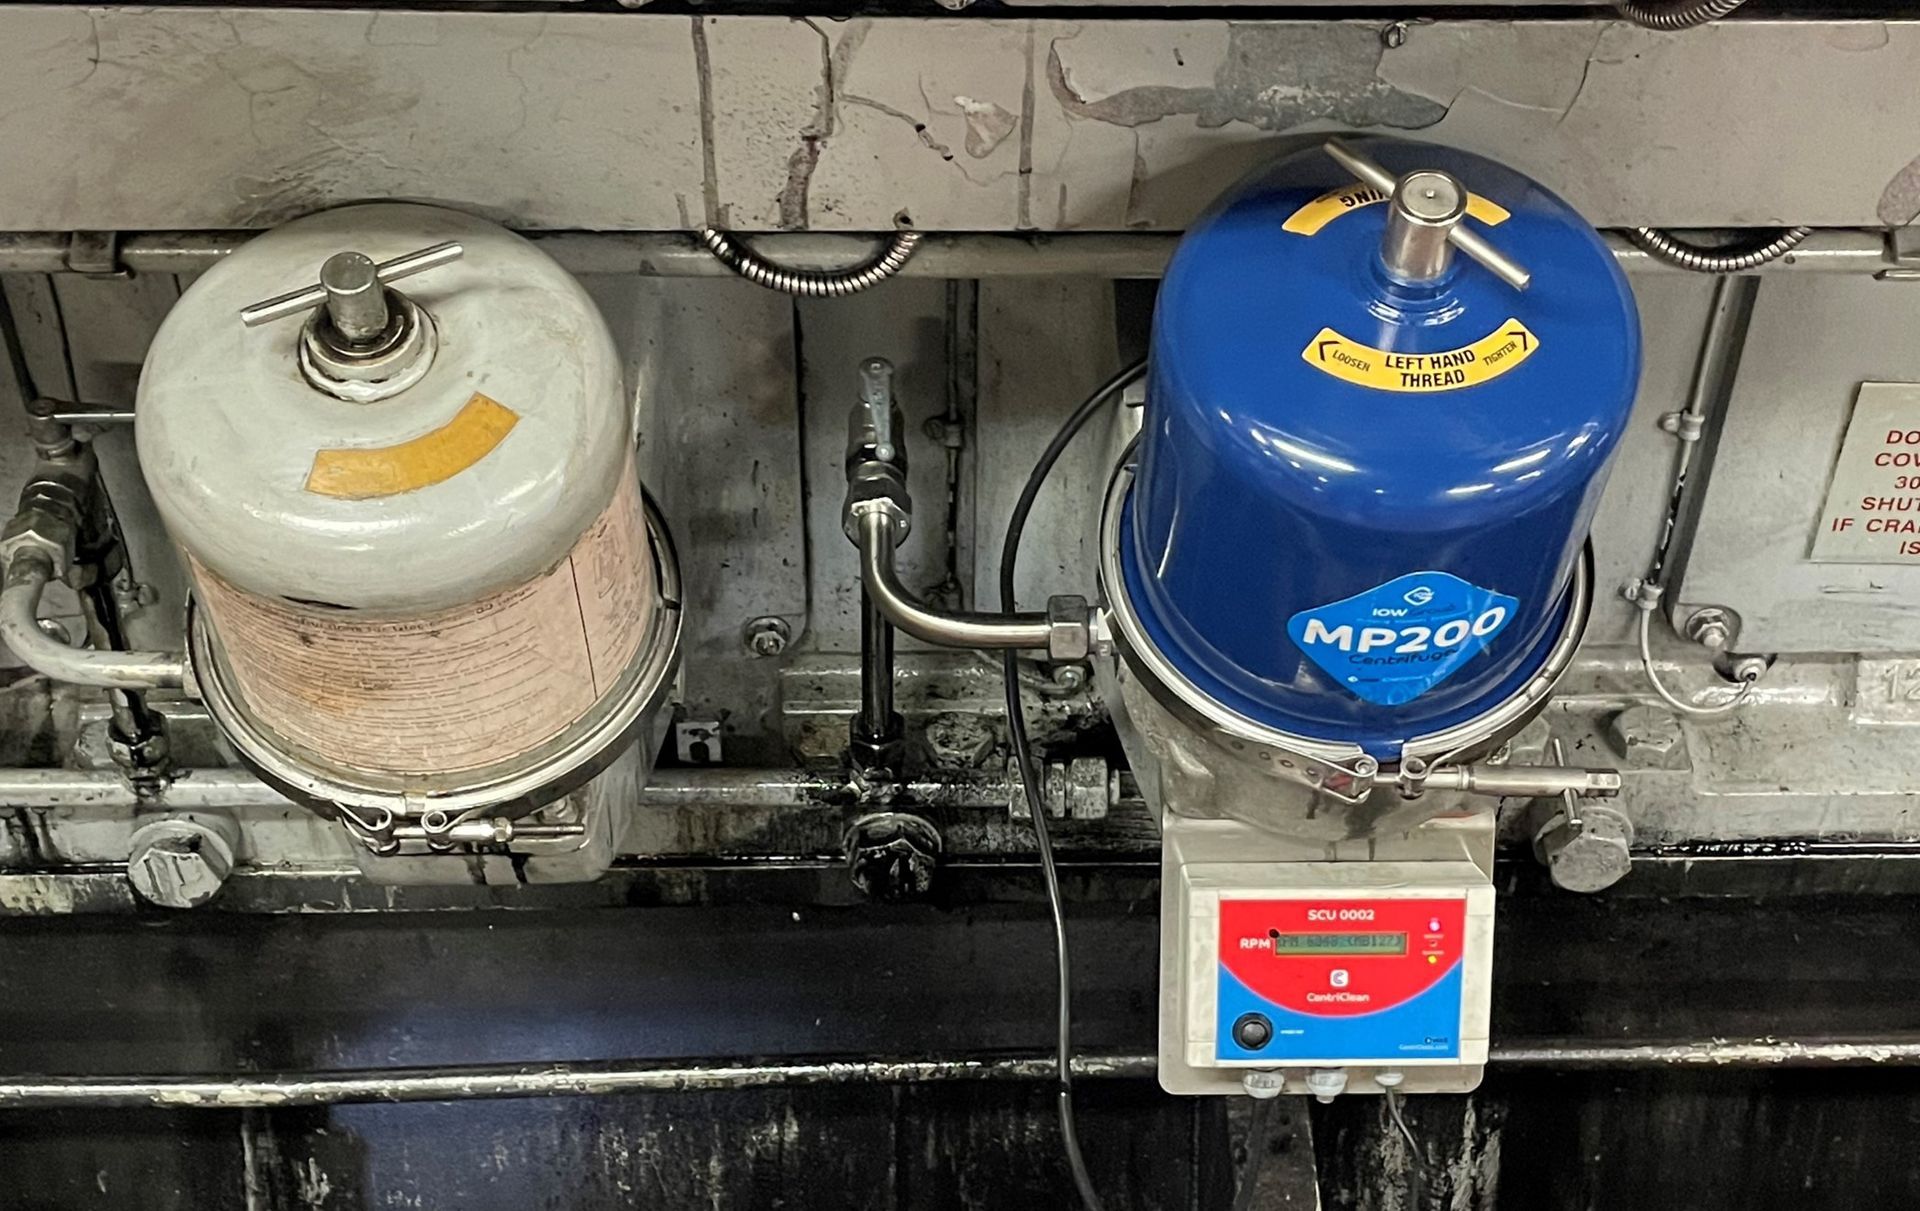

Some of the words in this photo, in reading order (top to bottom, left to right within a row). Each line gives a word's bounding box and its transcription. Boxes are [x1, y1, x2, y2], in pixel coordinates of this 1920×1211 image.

[1332, 349, 1371, 372] LOOSEN
[1385, 354, 1425, 370] LEFT
[1430, 349, 1476, 369] HAND
[1482, 340, 1518, 366] TIGHTEN
[1400, 369, 1466, 388] THREAD
[1886, 430, 1920, 445] DO
[1832, 518, 1855, 532] IF
[1866, 518, 1920, 533] CRA
[1372, 607, 1408, 617] IOW
[1303, 606, 1506, 654] MP200
[1307, 909, 1337, 921] SCU
[1339, 909, 1375, 921] 0002
[1239, 937, 1271, 949] RPM
